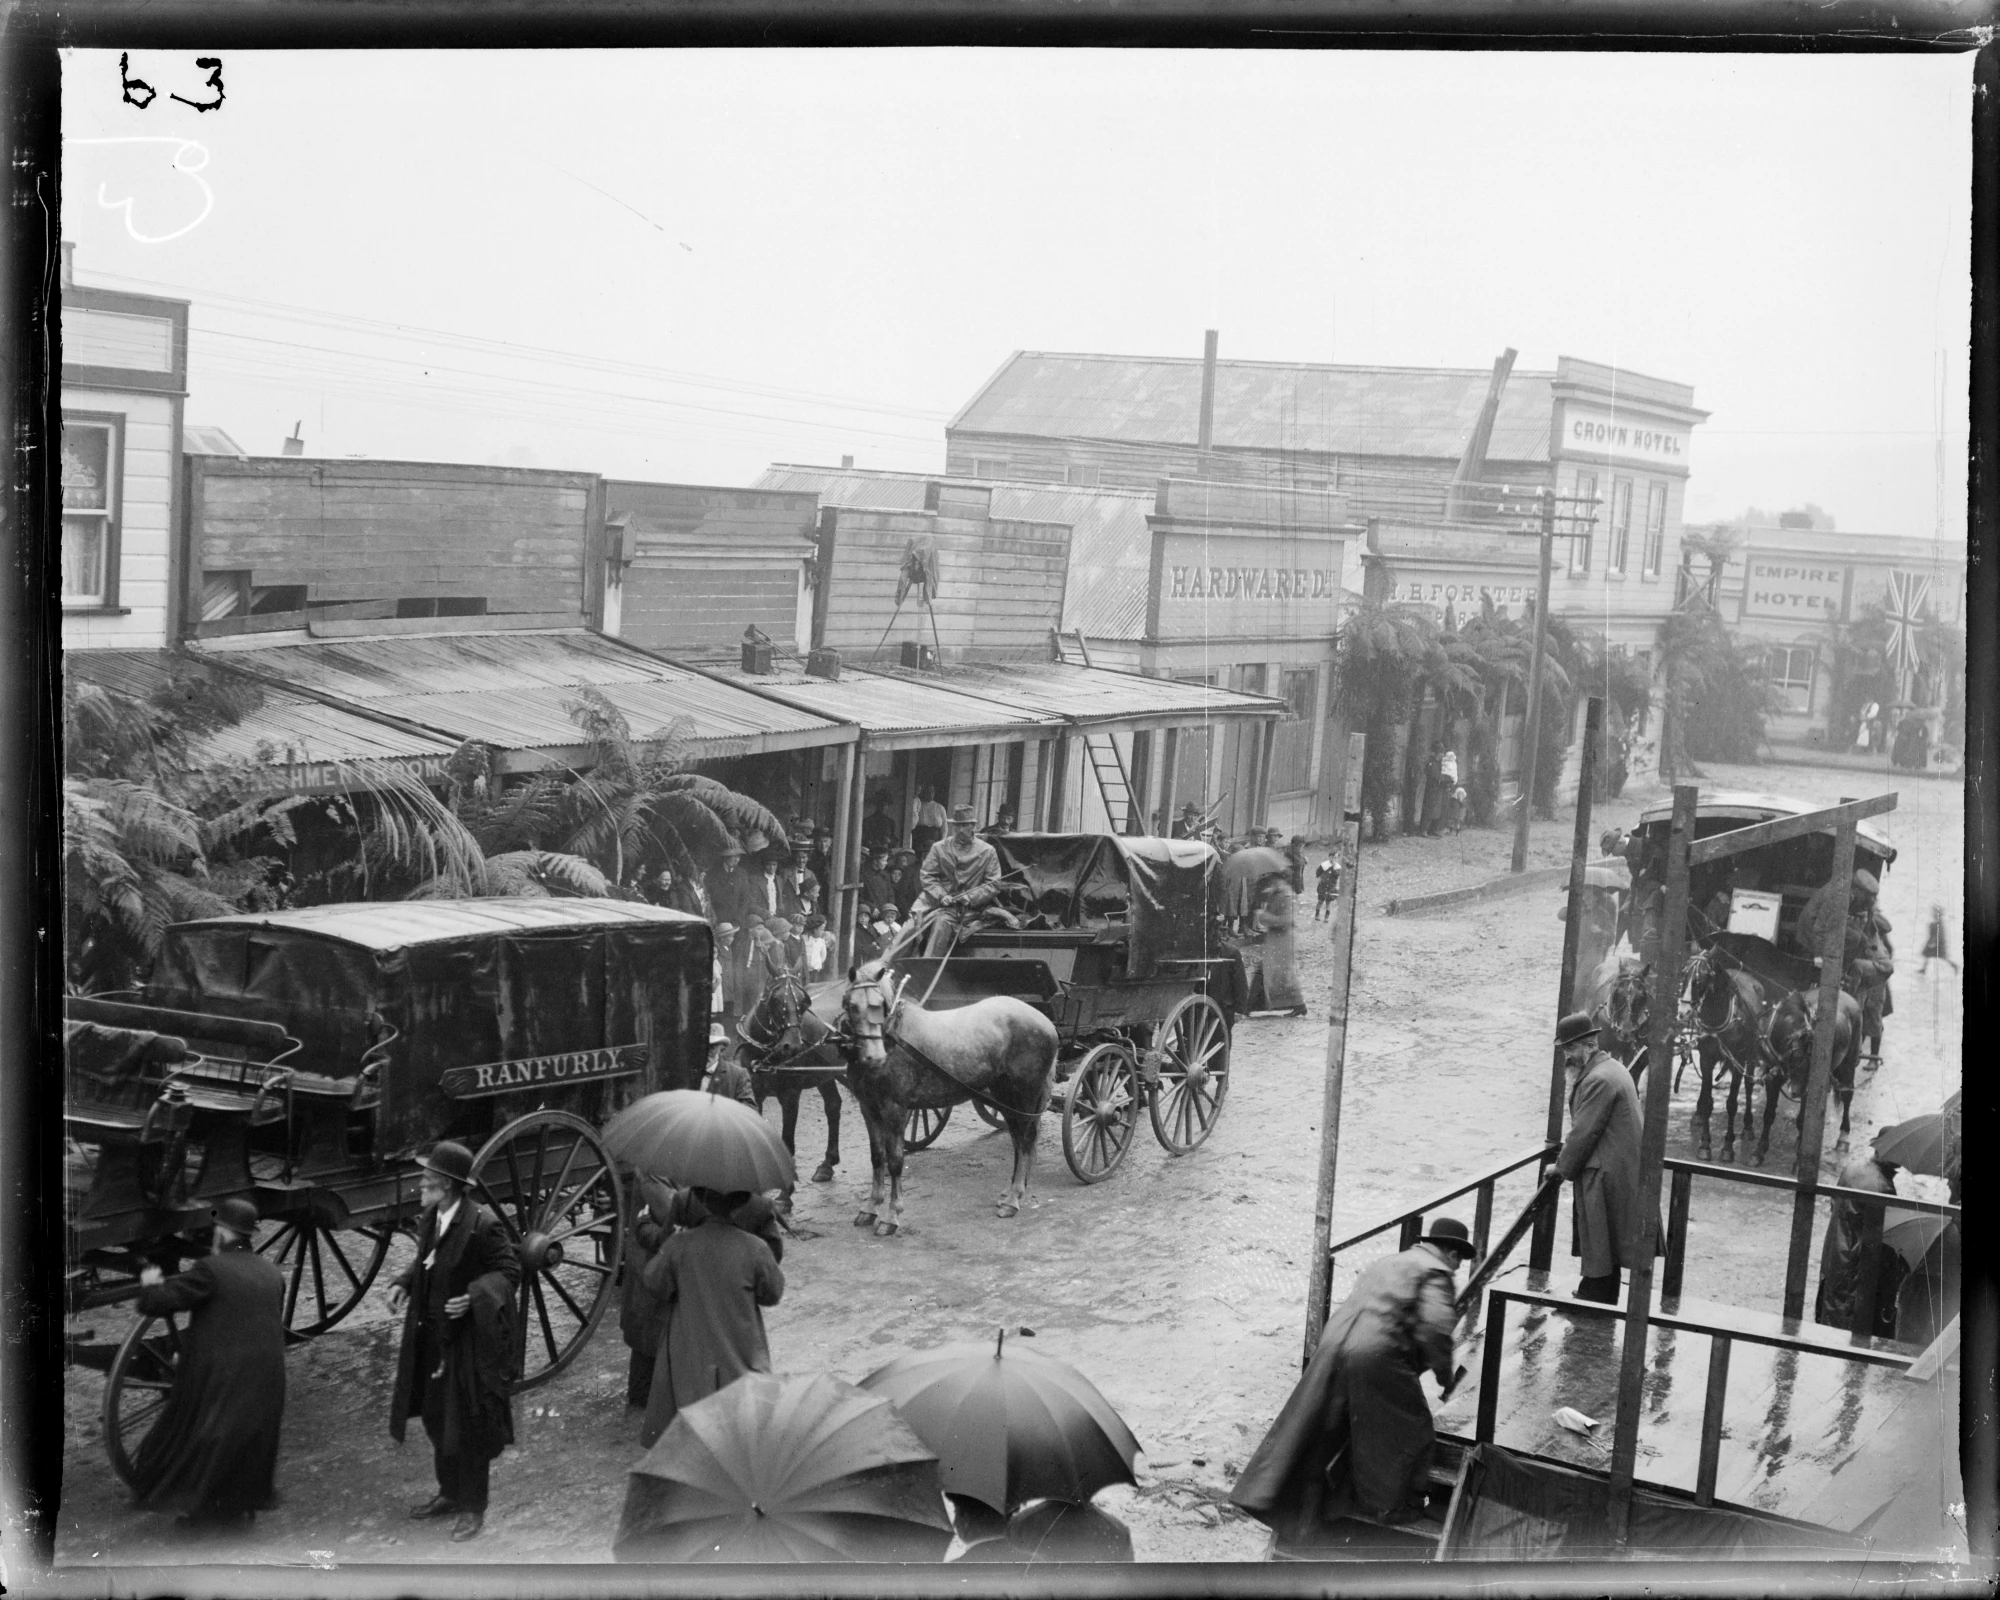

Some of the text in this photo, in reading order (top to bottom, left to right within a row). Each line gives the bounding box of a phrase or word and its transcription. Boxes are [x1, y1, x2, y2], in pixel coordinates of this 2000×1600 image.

[1574, 420, 1681, 455] CROWN HOTEL
[1169, 566, 1308, 600] HARDWARE
[1754, 565, 1840, 583] EMPIRE
[1753, 591, 1837, 609] HOTEL
